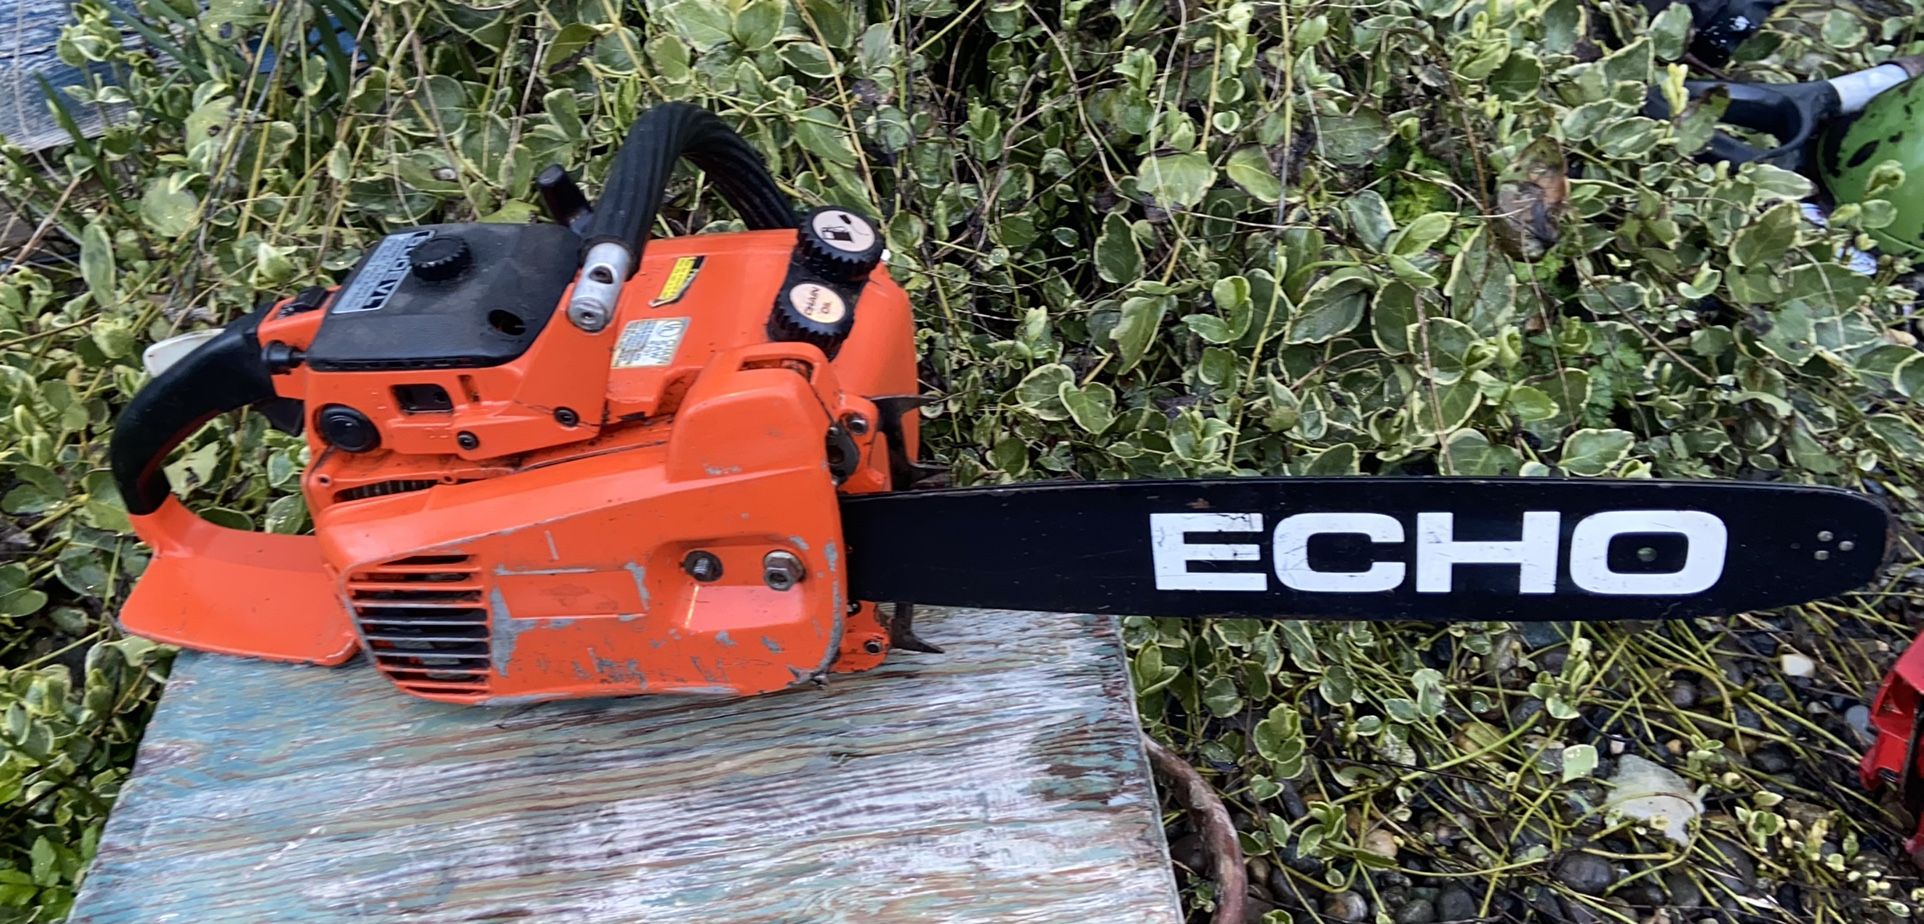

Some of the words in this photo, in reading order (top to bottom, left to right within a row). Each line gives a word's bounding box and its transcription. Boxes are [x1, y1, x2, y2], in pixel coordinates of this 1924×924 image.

[804, 286, 820, 315] CHAIN
[820, 301, 832, 315] OIL
[1149, 510, 1728, 596] ECHO
